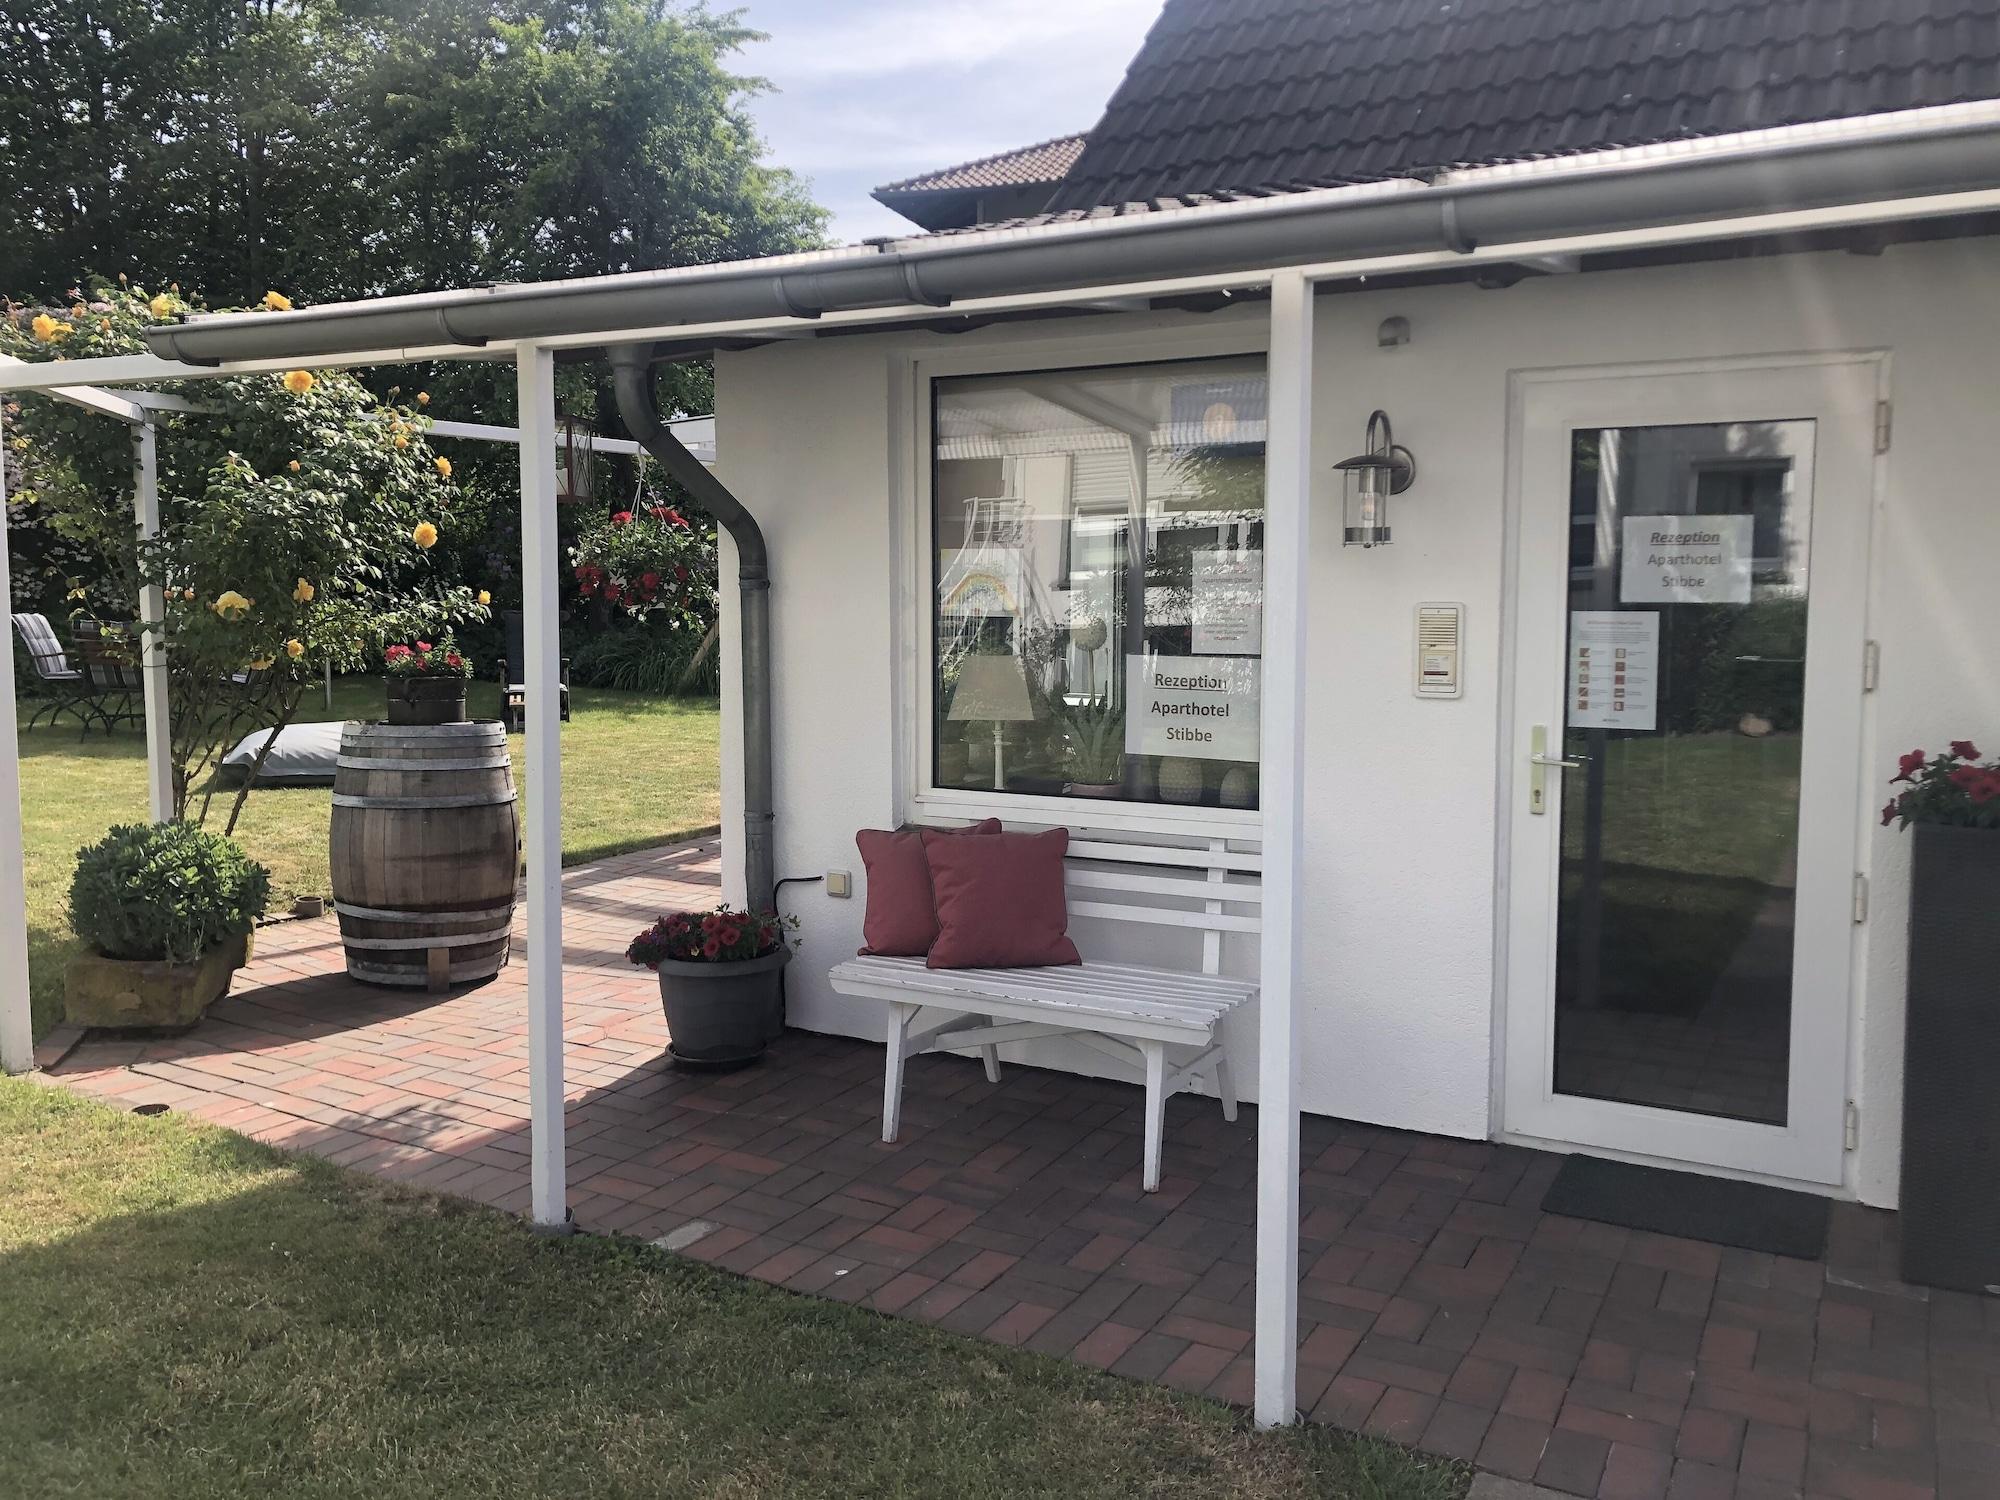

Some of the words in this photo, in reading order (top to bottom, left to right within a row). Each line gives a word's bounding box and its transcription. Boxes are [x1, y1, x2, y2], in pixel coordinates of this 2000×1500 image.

[1650, 531, 1720, 545] Rezeption
[1647, 553, 1722, 567] Aparthotel
[1662, 576, 1705, 587] Stibbe
[1155, 673, 1227, 690] Rezeption
[1151, 701, 1229, 716] Aparthotel
[1166, 727, 1212, 742] Stibbe
